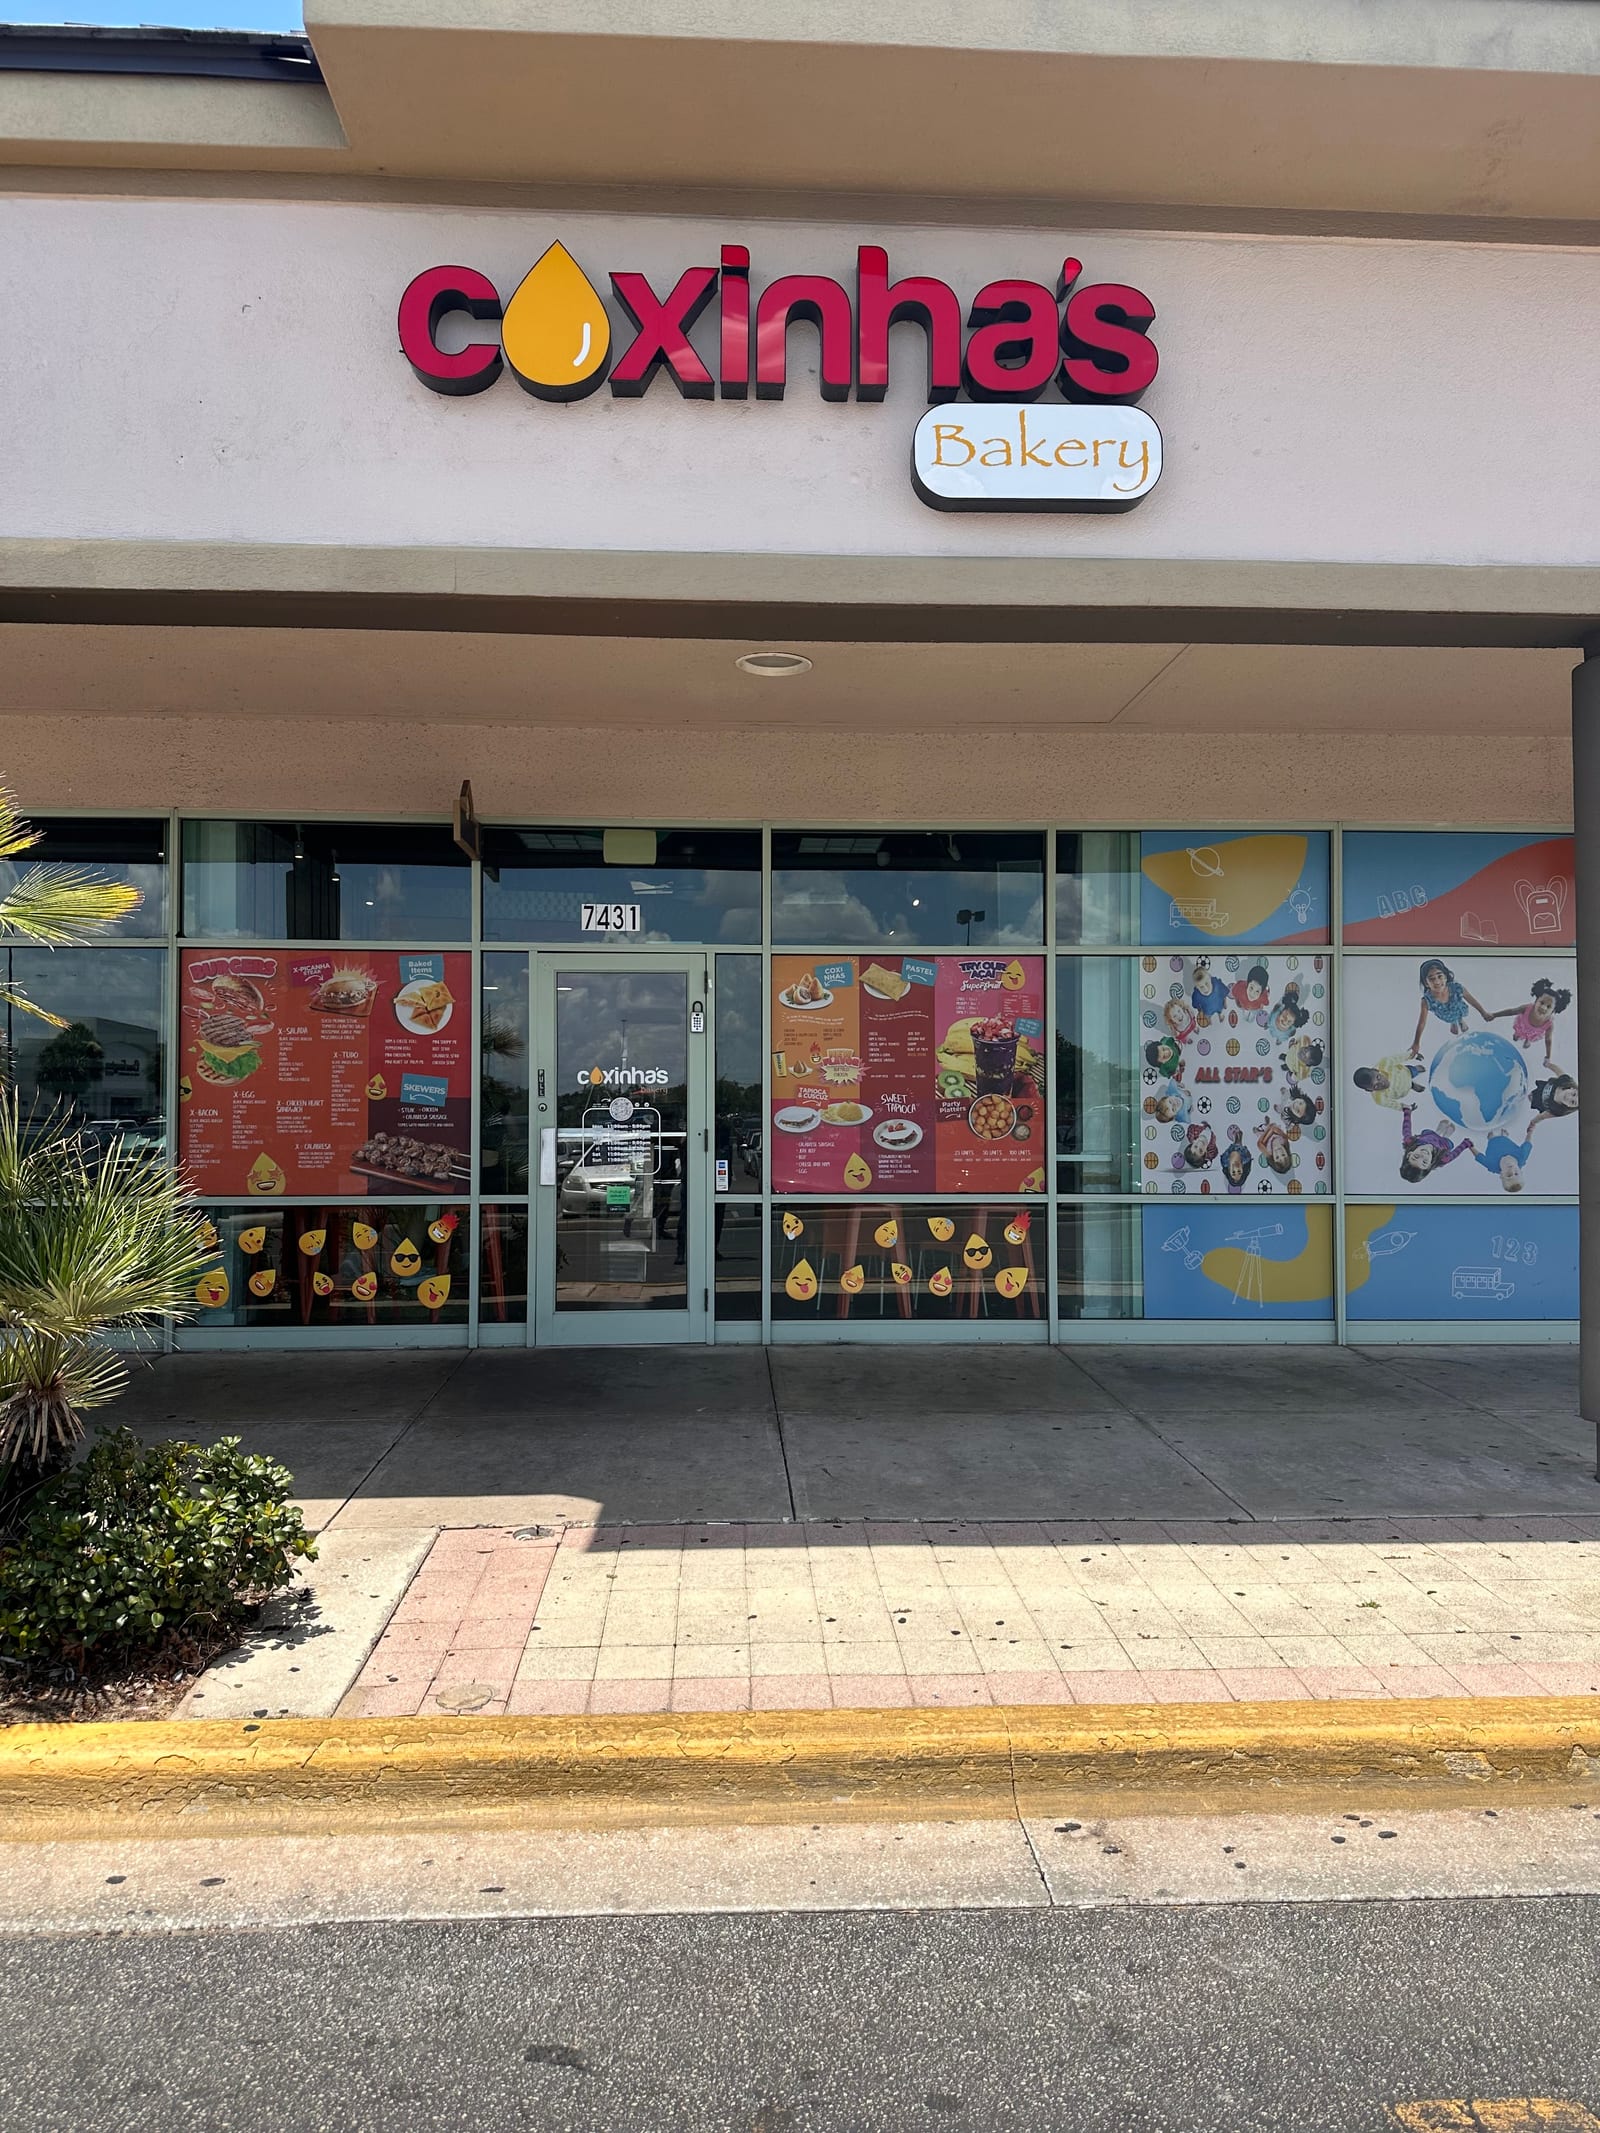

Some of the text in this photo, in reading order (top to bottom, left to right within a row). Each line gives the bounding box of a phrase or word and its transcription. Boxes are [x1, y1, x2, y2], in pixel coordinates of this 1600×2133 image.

[932, 411, 1149, 491] Bakery
[1376, 885, 1428, 919] ABC
[583, 905, 637, 930] 7431
[825, 967, 843, 975] COXI
[905, 964, 934, 976] PASTEL
[959, 961, 1007, 972] TRY OUR
[824, 973, 846, 981] NHAS
[577, 1066, 669, 1085] coxinha's
[1195, 1066, 1273, 1083] ALL STAR'S
[403, 1083, 446, 1095] SKEWERS
[799, 1087, 827, 1095] TAPIOCA
[881, 1093, 907, 1104] SWEET
[886, 1103, 917, 1113] TAPIOCA
[940, 1105, 967, 1113] Platters
